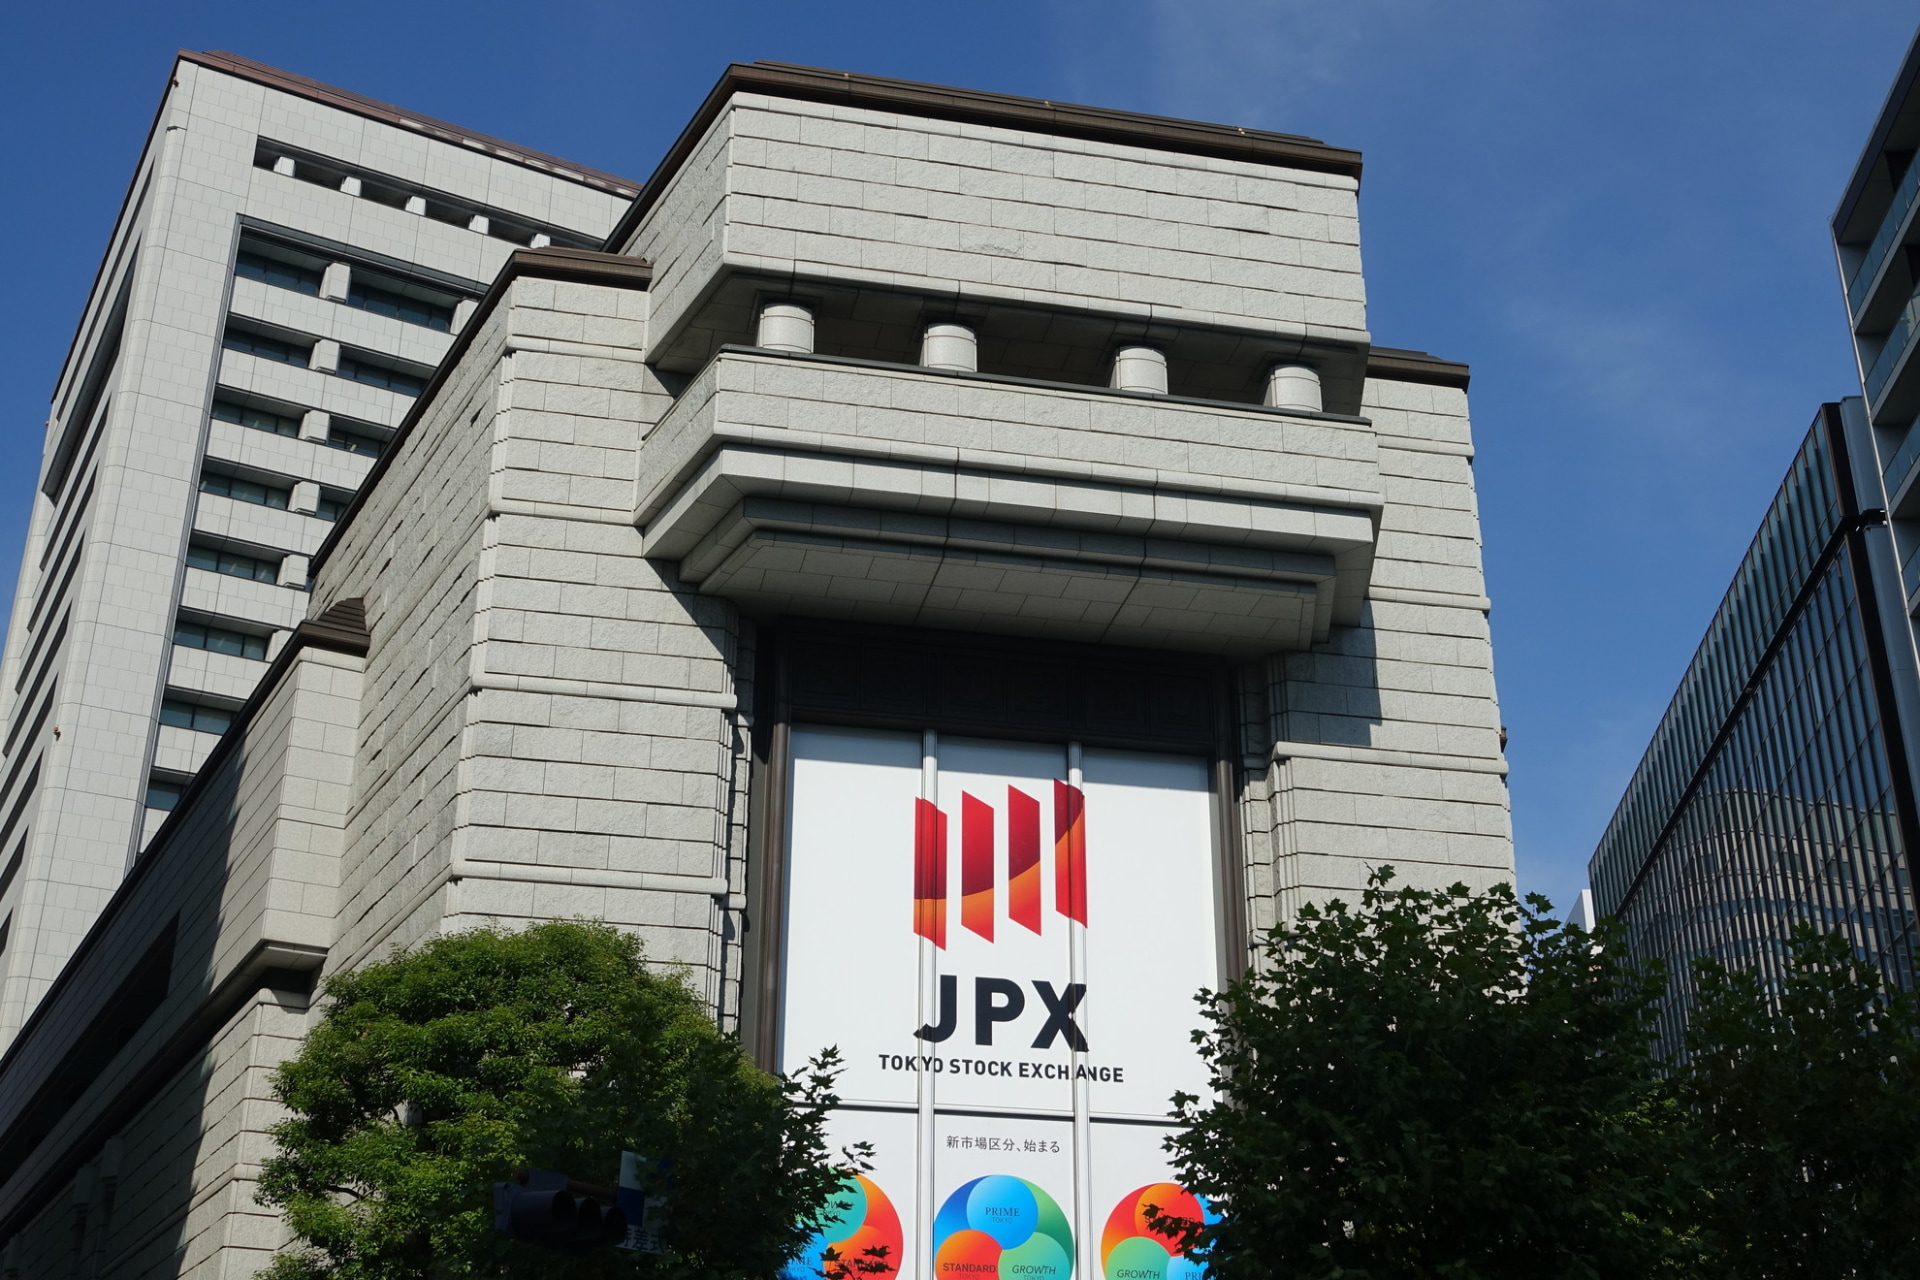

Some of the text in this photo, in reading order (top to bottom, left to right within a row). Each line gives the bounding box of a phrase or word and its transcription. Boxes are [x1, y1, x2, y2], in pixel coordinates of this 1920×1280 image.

[913, 974, 1090, 1053] JPX
[878, 1054, 1124, 1083] TOKYO STOCK EXCHANGE
[946, 1135, 1060, 1153] 新市場区分、始まる
[985, 1206, 1020, 1217] PRIME
[992, 1216, 1013, 1224] TOKYO
[943, 1262, 996, 1273] STANDARD
[1012, 1264, 1056, 1275] GROWTH
[1116, 1269, 1160, 1279] GROWTH
